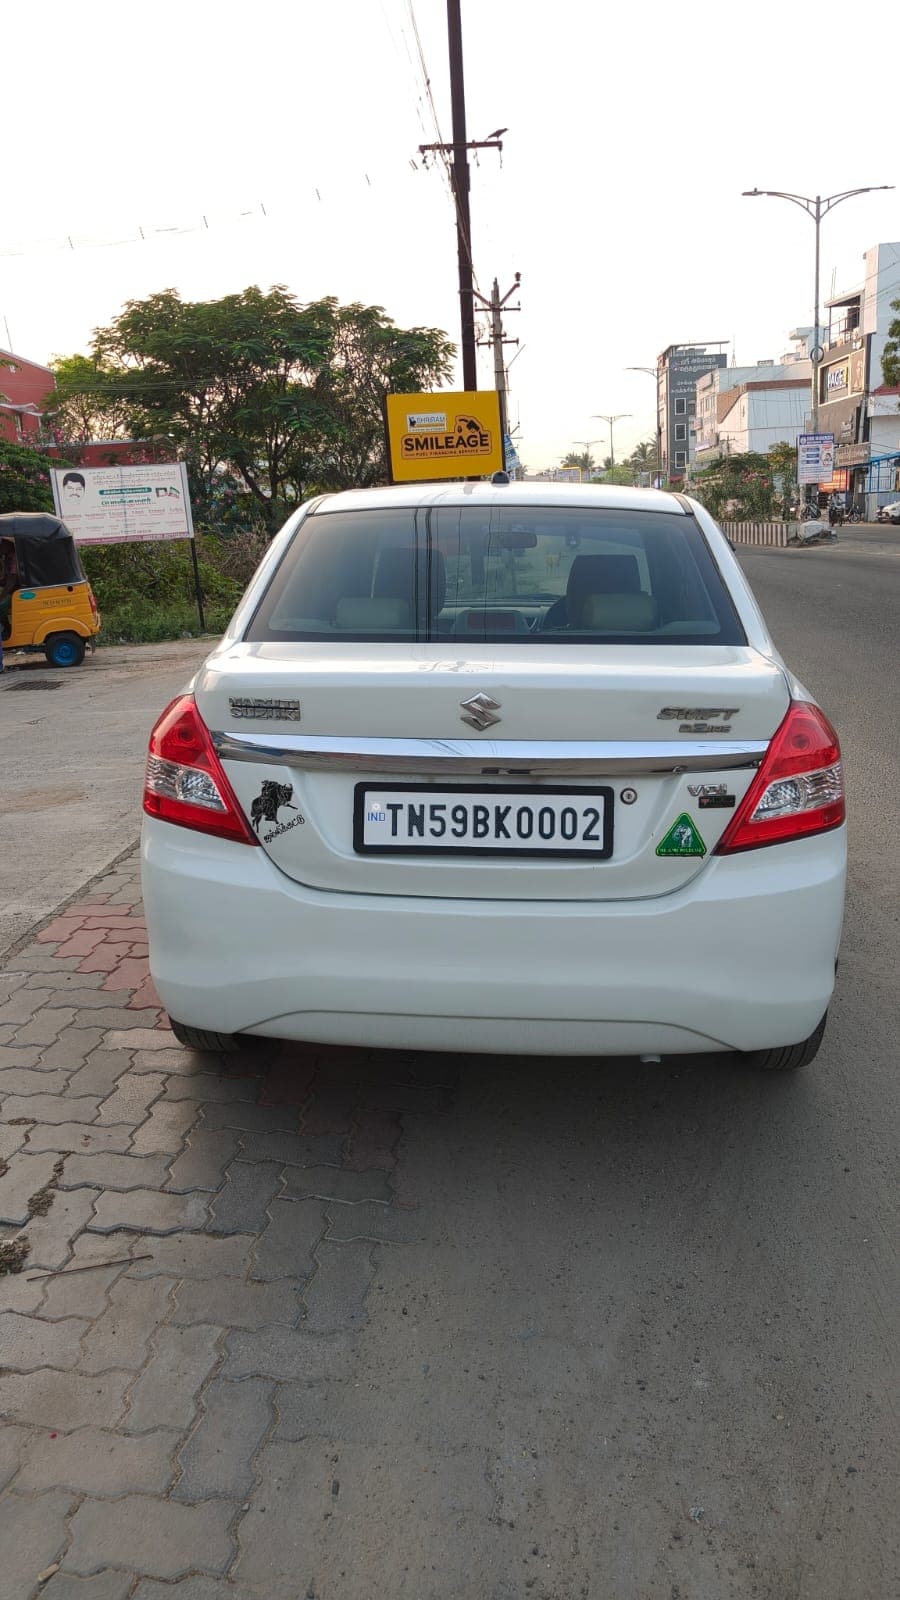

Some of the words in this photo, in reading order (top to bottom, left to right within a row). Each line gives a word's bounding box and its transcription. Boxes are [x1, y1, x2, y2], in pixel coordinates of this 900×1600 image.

[404, 433, 490, 452] SMILEAGE
[230, 707, 301, 721] SUZUKI
[656, 708, 740, 721] SWIFT
[367, 812, 386, 822] IND
[386, 803, 601, 841] TN59BK0002
